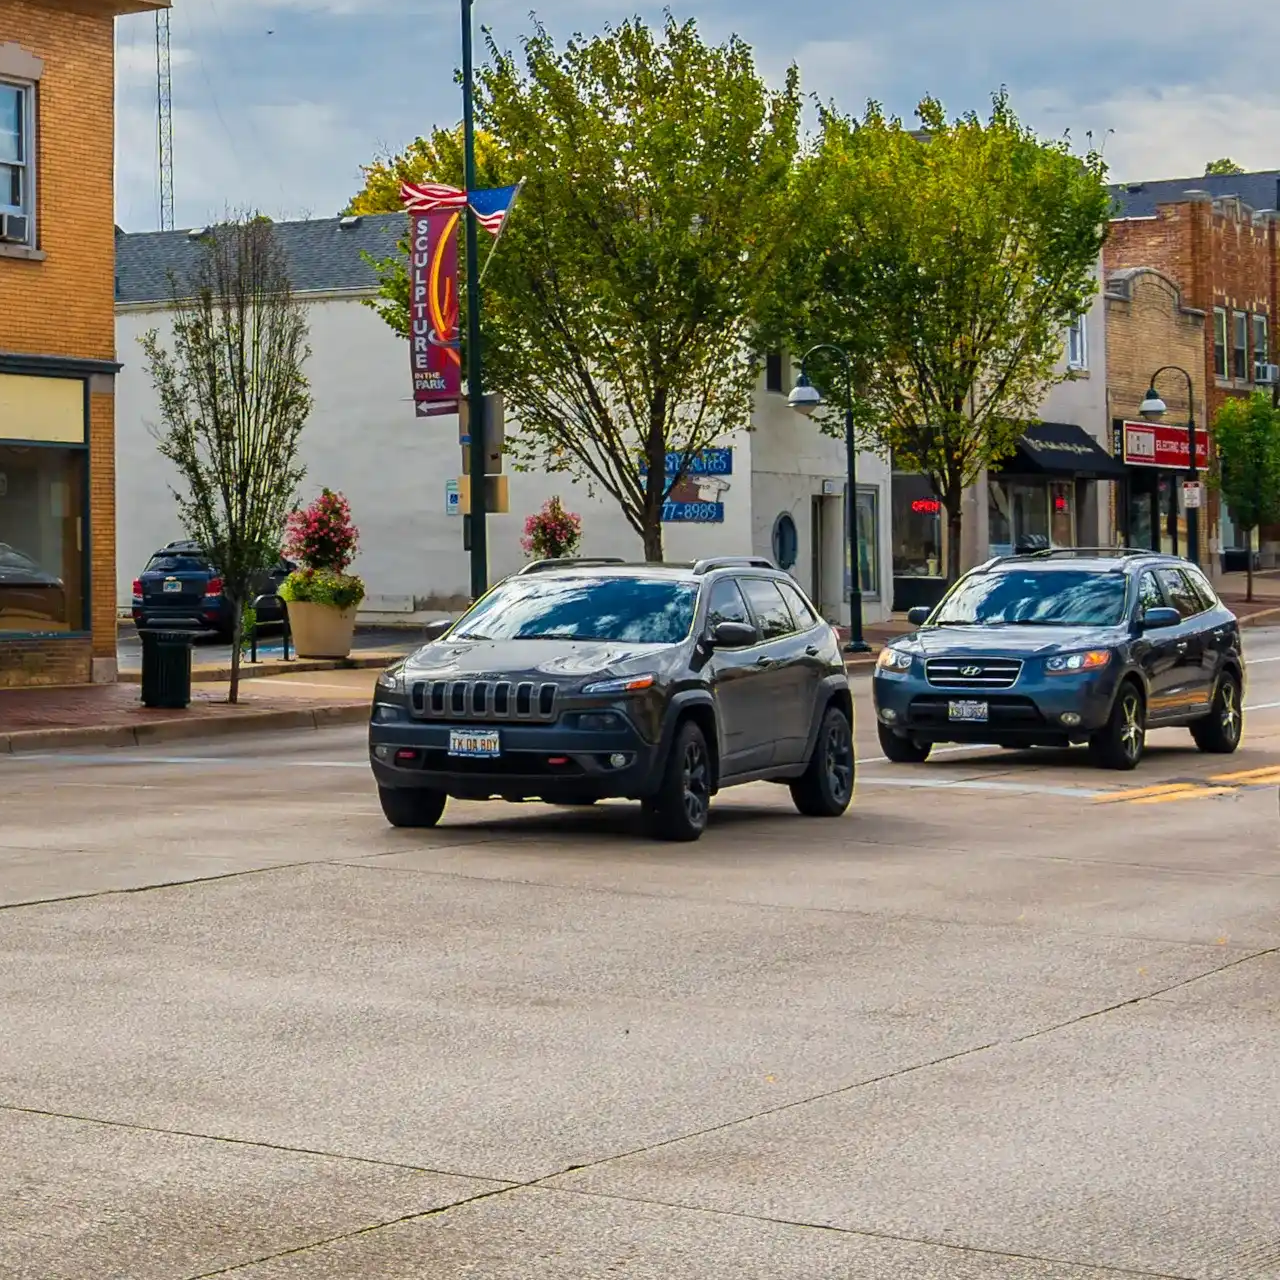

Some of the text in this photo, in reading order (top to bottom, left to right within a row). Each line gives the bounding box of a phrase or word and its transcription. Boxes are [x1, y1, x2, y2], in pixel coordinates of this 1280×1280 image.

[413, 219, 428, 369] SCULPTURE
[424, 371, 441, 380] THE
[415, 379, 447, 390] PARK
[662, 503, 717, 521] 77-8989
[911, 499, 941, 512] OPEN
